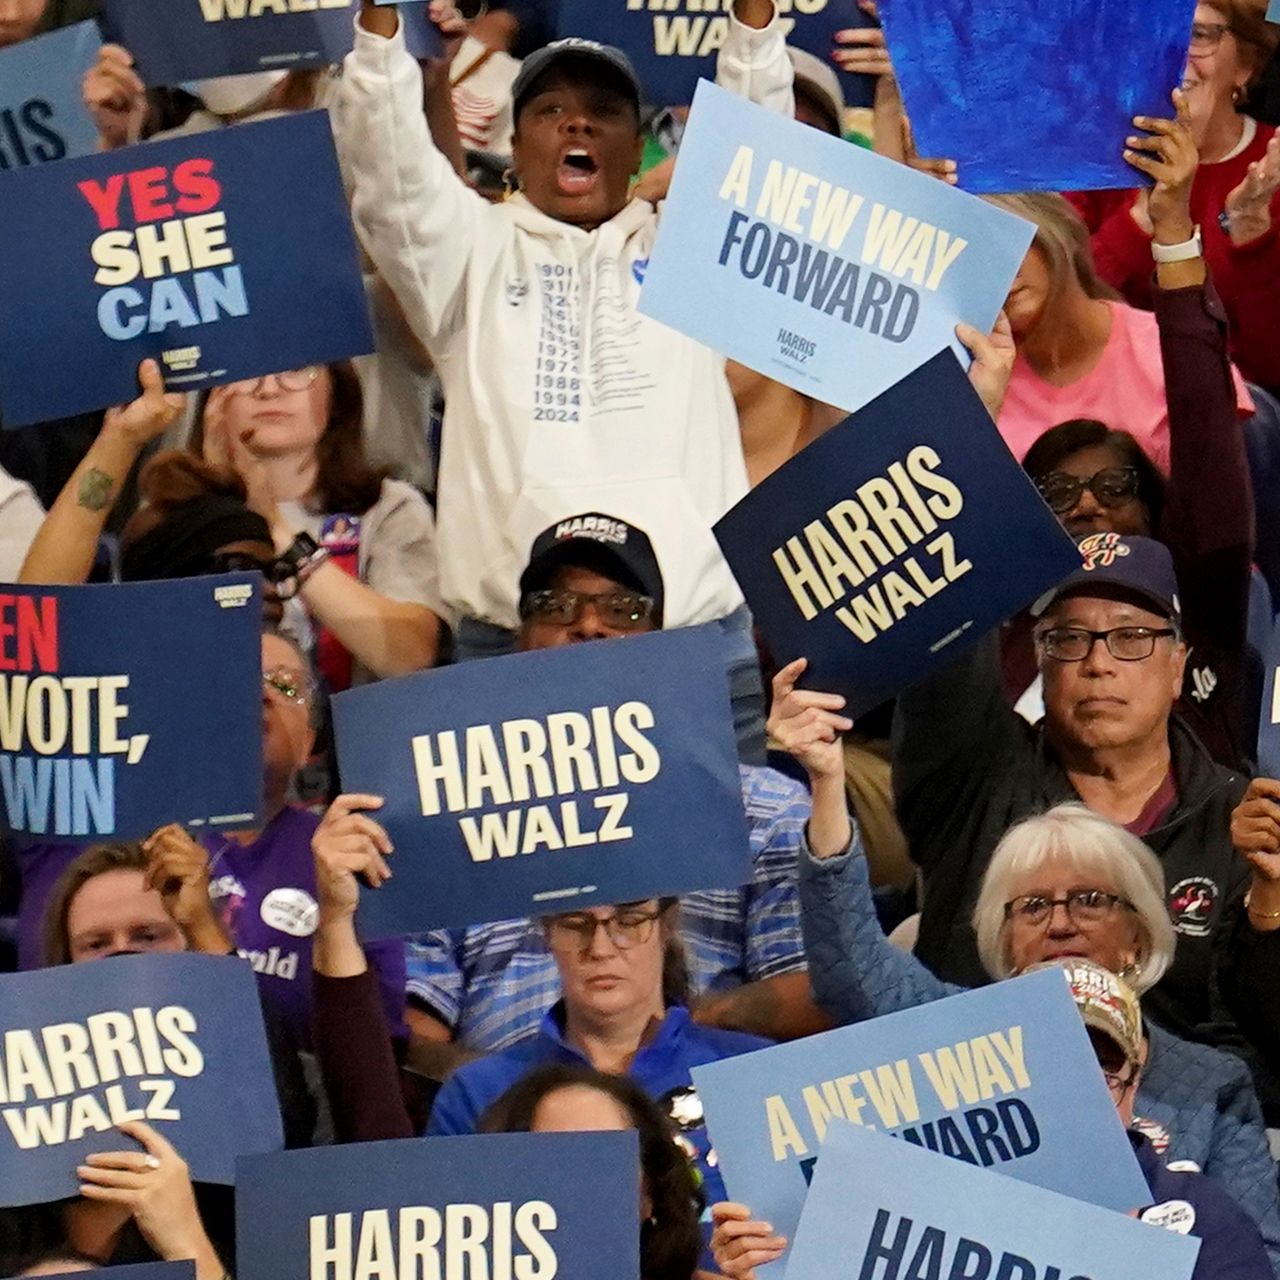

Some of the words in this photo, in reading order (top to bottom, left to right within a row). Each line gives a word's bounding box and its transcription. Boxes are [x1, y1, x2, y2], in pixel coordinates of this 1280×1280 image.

[77, 157, 221, 230] YES
[720, 145, 756, 208] A
[755, 160, 863, 251] NEW
[861, 204, 968, 290] WAY
[91, 212, 234, 286] SHE
[718, 210, 920, 344] FORWARD
[97, 265, 249, 341] CAN
[776, 327, 817, 356] HARRIS
[780, 344, 807, 364] WALZ
[534, 391, 581, 408] 1994
[534, 408, 580, 423] 2024
[771, 444, 964, 622] HARRIS
[836, 531, 973, 645] WALZ
[411, 700, 661, 818] HARRIS
[460, 792, 633, 863] WALZ
[0, 1005, 204, 1106] ARRIS
[764, 1094, 806, 1162] A
[917, 1025, 1032, 1111] WAY
[4, 1079, 181, 1151] WALZ
[308, 1200, 557, 1280] HARRIS
